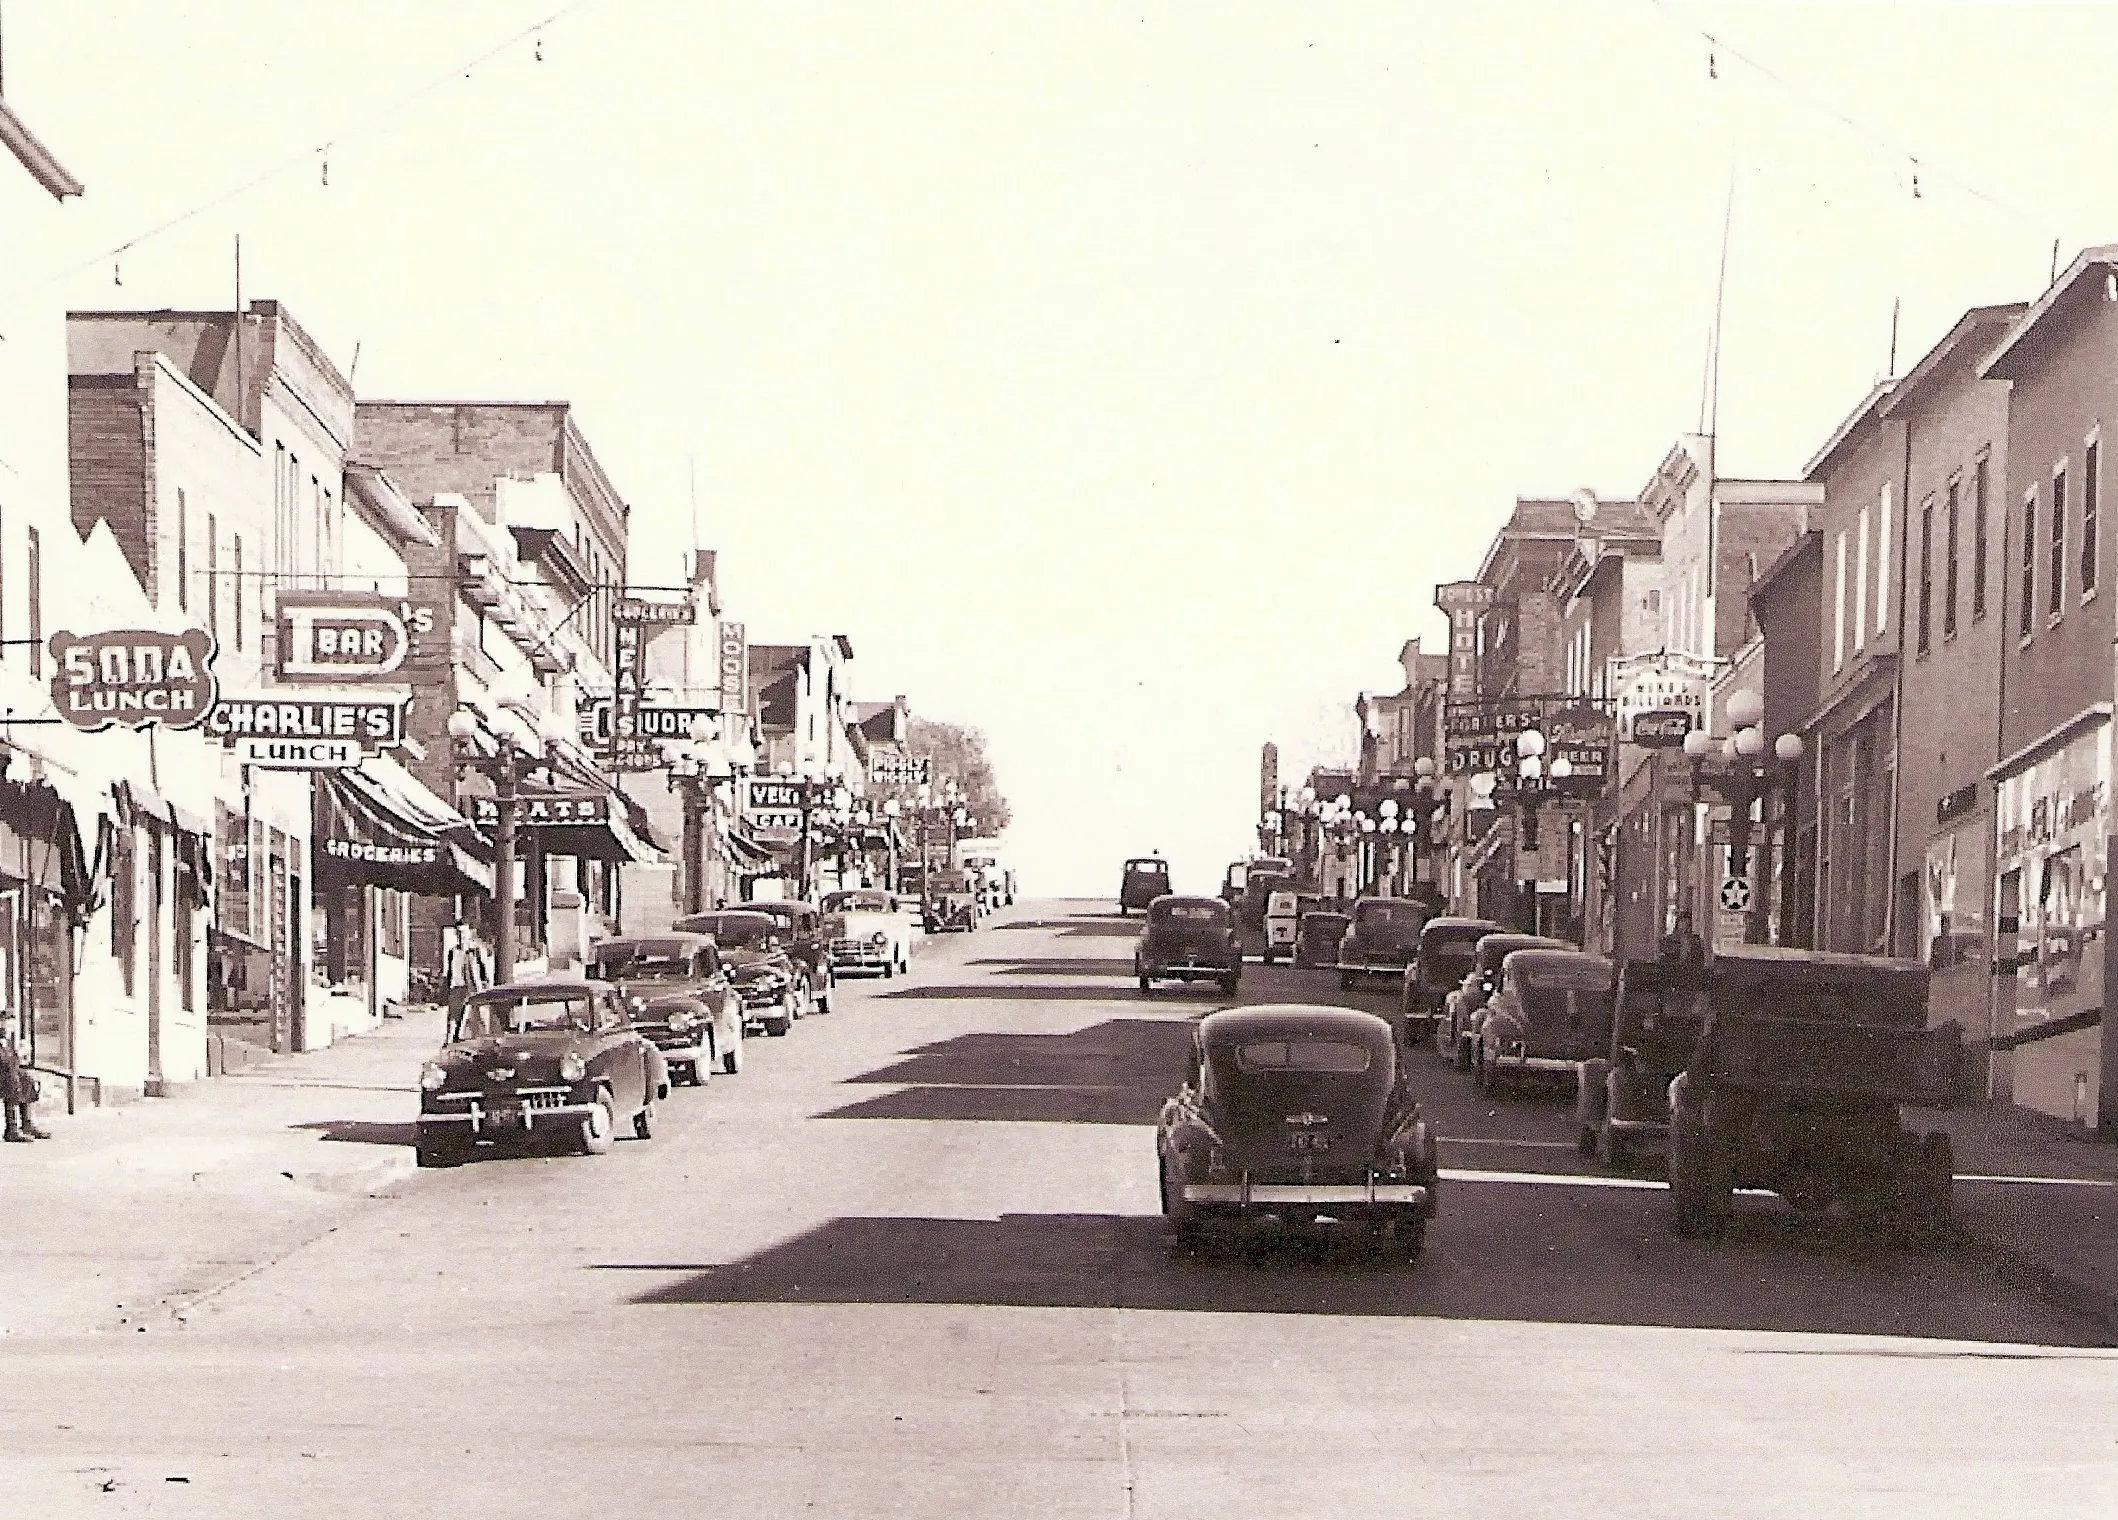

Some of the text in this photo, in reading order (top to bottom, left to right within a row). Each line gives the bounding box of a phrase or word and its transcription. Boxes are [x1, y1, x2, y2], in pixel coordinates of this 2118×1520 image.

[318, 628, 383, 656] BAR
[64, 645, 199, 685] SODA
[617, 626, 638, 735] MEATS
[69, 689, 195, 711] LUNCH
[209, 702, 391, 737] CHARLIE'S
[1452, 746, 1513, 771] DRUG
[477, 800, 597, 818] MATS
[326, 839, 437, 864] GROCERIES
